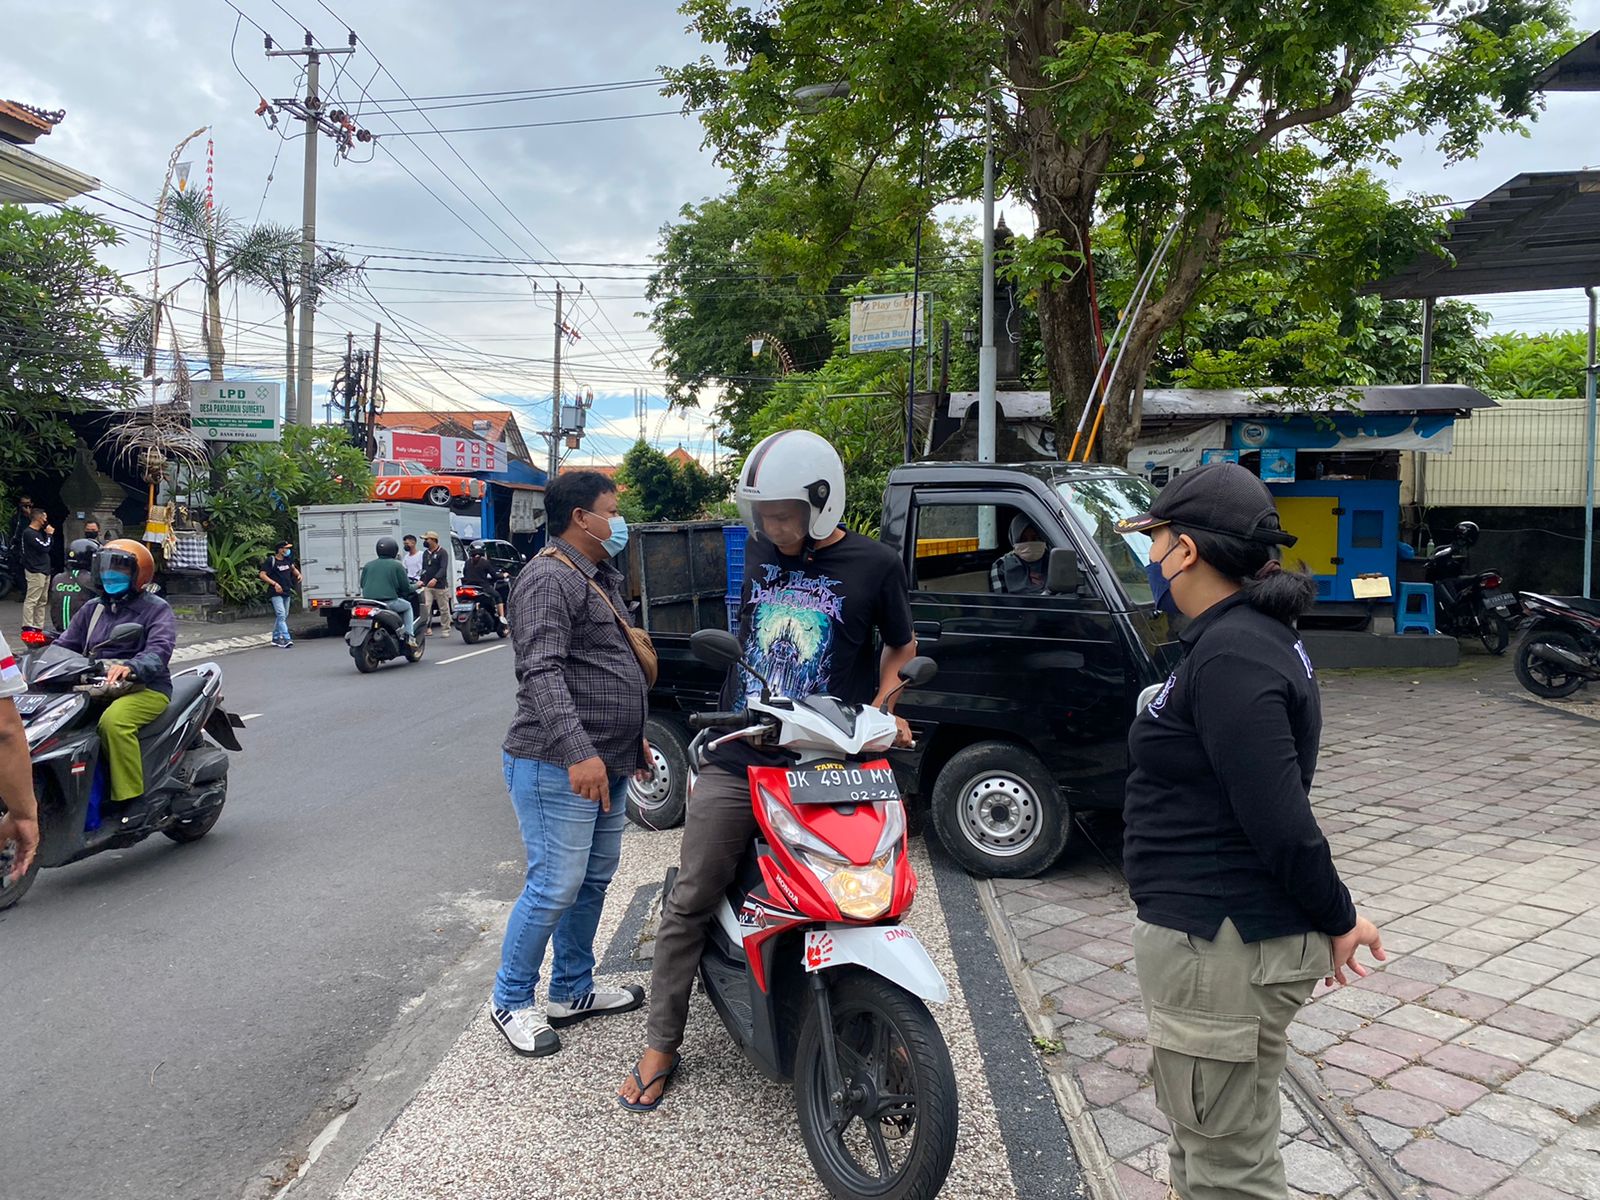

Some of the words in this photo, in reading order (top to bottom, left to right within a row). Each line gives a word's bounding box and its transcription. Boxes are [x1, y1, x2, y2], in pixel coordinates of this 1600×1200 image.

[852, 331, 890, 342] Permata
[219, 389, 246, 399] LPD
[200, 404, 213, 413] DESA
[375, 479, 400, 496] 60
[55, 582, 82, 593] Grab
[785, 771, 810, 788] DK
[820, 769, 863, 786] 4910
[870, 769, 893, 784] MY
[775, 873, 800, 905] HONDA
